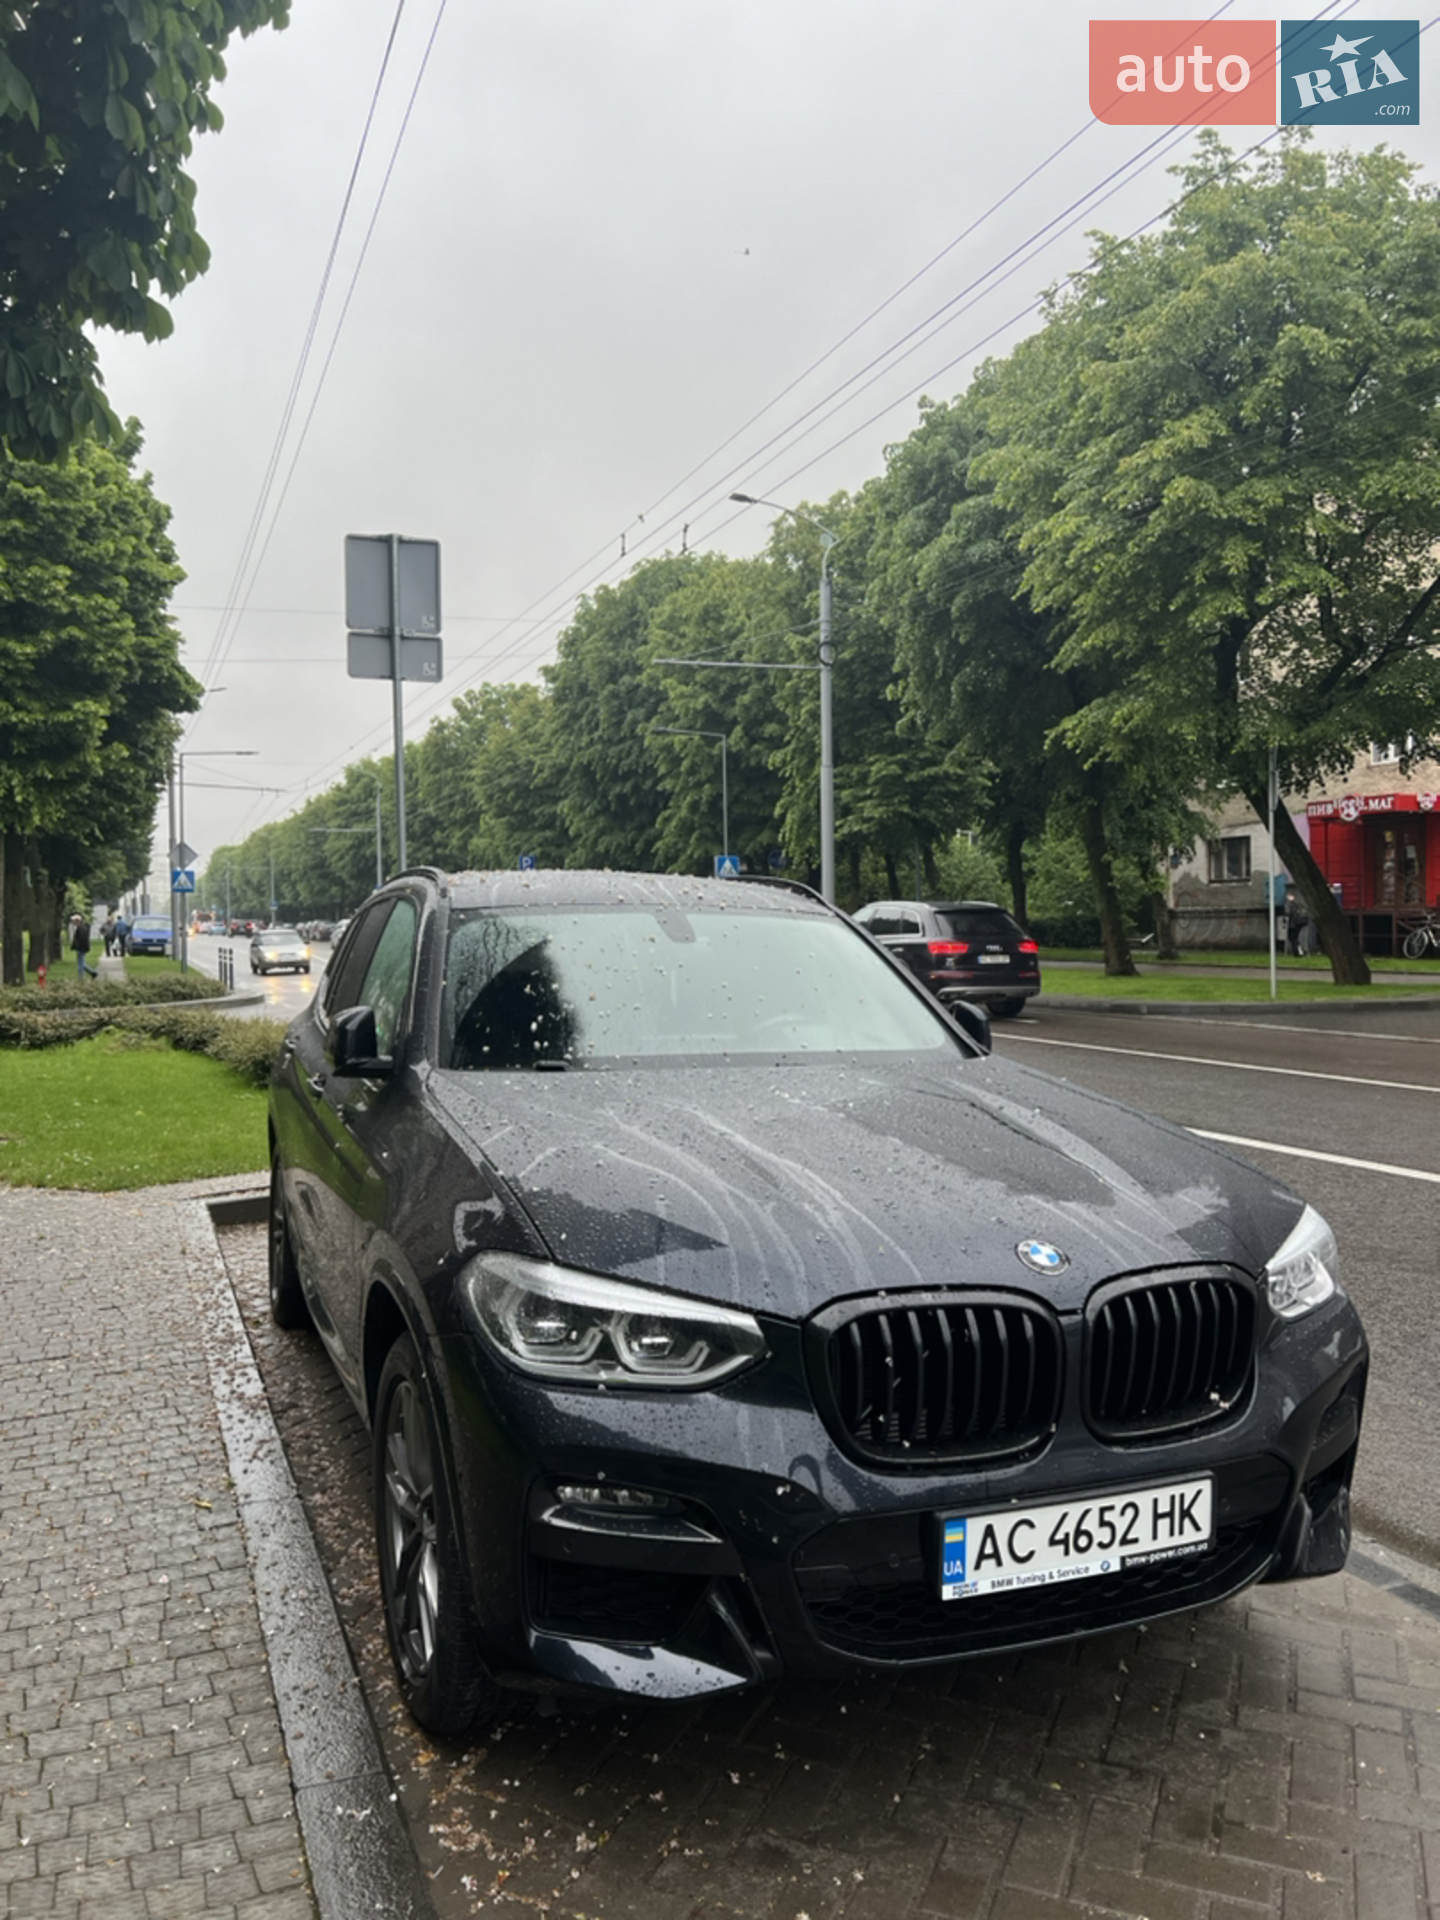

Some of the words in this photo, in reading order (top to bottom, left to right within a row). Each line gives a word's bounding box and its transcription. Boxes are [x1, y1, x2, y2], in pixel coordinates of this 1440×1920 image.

[973, 1518, 1037, 1571] AC
[1048, 1501, 1140, 1557] 4652
[1151, 1488, 1204, 1541] HK
[943, 1559, 964, 1577] UA
[990, 1576, 1014, 1590] BMW
[1016, 1572, 1046, 1587] Tuning
[1049, 1570, 1055, 1580] &
[1056, 1564, 1090, 1578] Service
